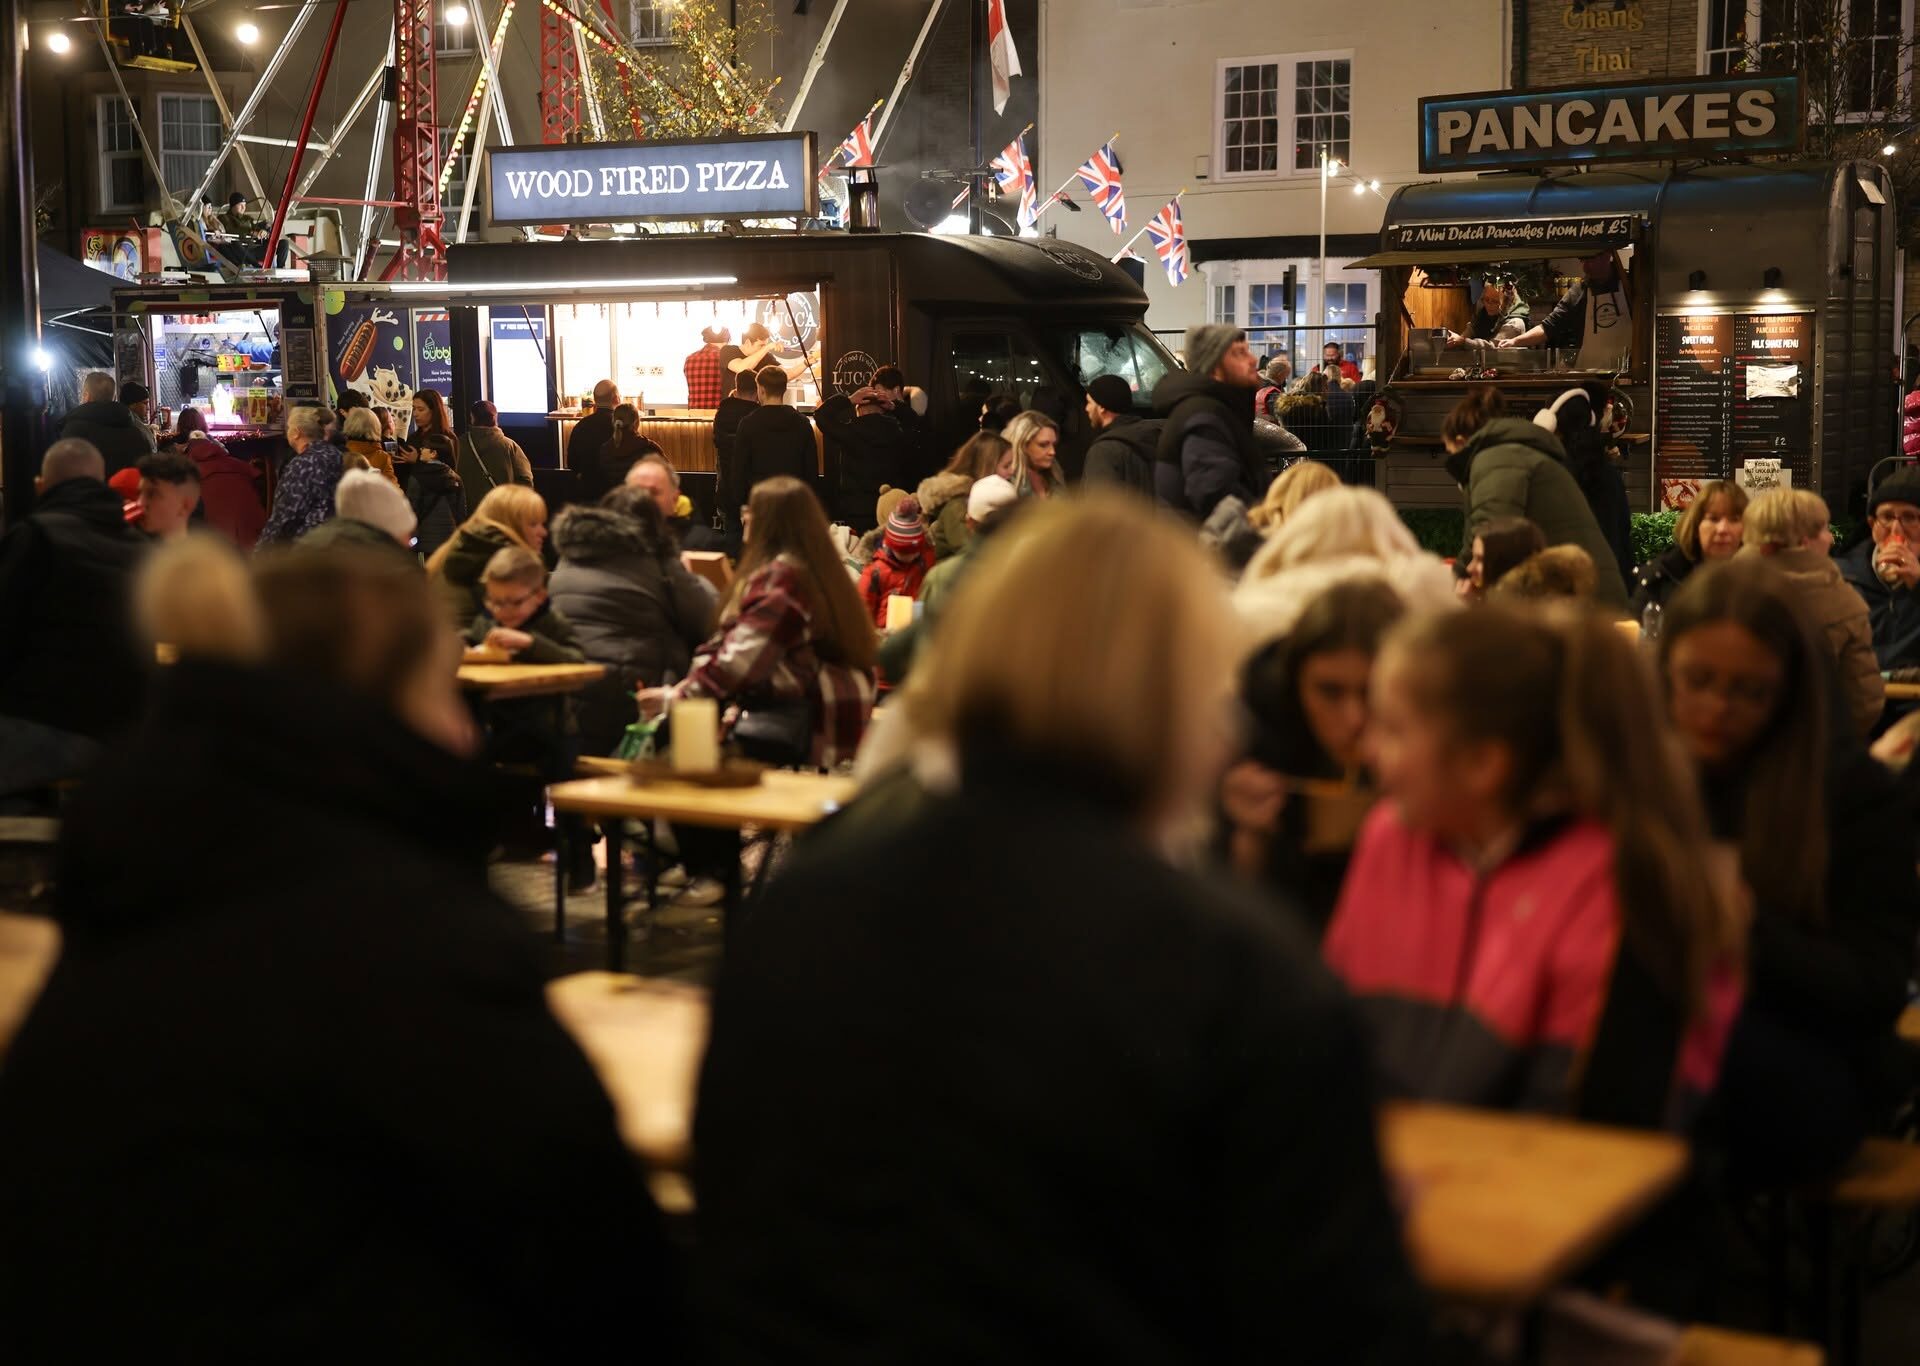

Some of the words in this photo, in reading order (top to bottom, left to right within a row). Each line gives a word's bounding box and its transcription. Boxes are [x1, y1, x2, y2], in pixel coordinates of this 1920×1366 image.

[1575, 46, 1632, 72] Thai
[1437, 90, 1776, 155] PANCAKES
[505, 169, 593, 199] WOOD
[599, 165, 690, 196] FIRED
[696, 160, 789, 191] PIZZA
[1400, 229, 1413, 243] 12
[1415, 227, 1445, 242] Mini
[1448, 226, 1483, 241] Dutch
[1486, 223, 1543, 239] Pancakes
[1546, 222, 1577, 240] from
[1579, 220, 1604, 239] just
[1607, 219, 1628, 234] £5
[1681, 335, 1699, 345] SWEET
[1699, 335, 1714, 344] MENU
[1751, 340, 1764, 349] MILK
[1783, 339, 1799, 348] MENU
